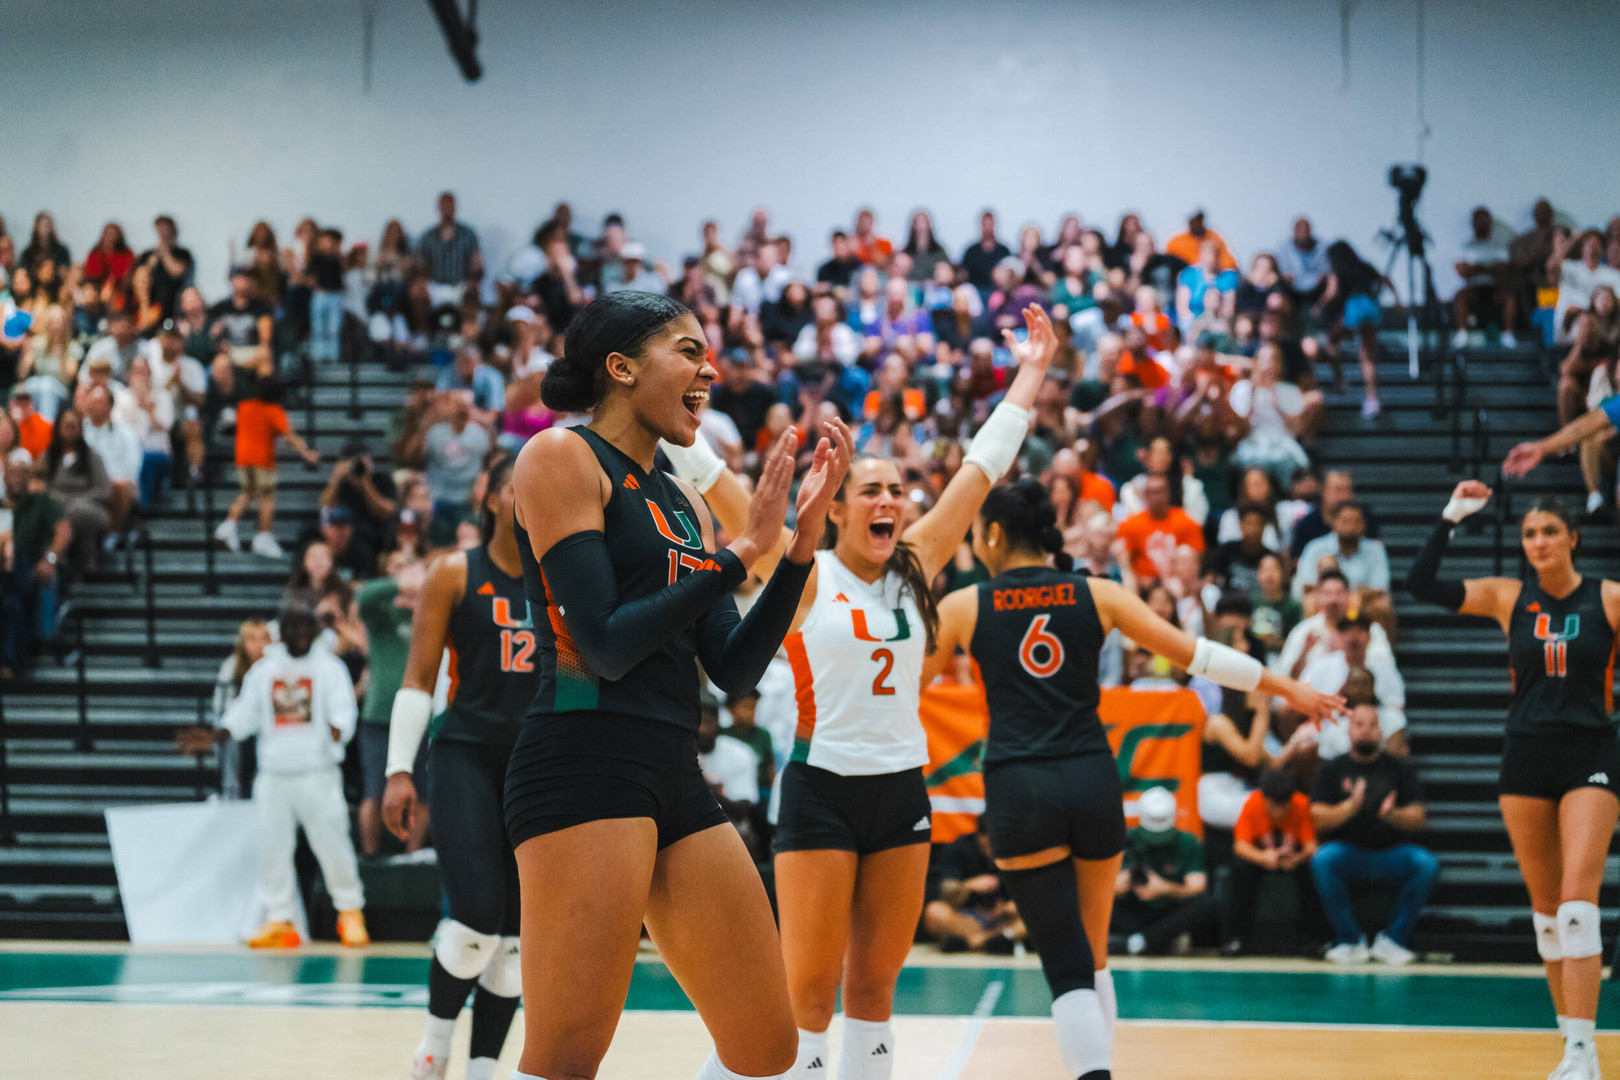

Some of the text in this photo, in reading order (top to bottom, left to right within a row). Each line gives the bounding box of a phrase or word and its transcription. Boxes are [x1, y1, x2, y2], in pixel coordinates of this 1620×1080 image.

[645, 498, 702, 550] U
[993, 583, 1077, 611] RODRIGUEZ
[851, 608, 911, 642] U
[1018, 613, 1065, 679] 6
[500, 630, 536, 672] 12
[871, 647, 895, 695] 2
[1544, 641, 1567, 678] 11
